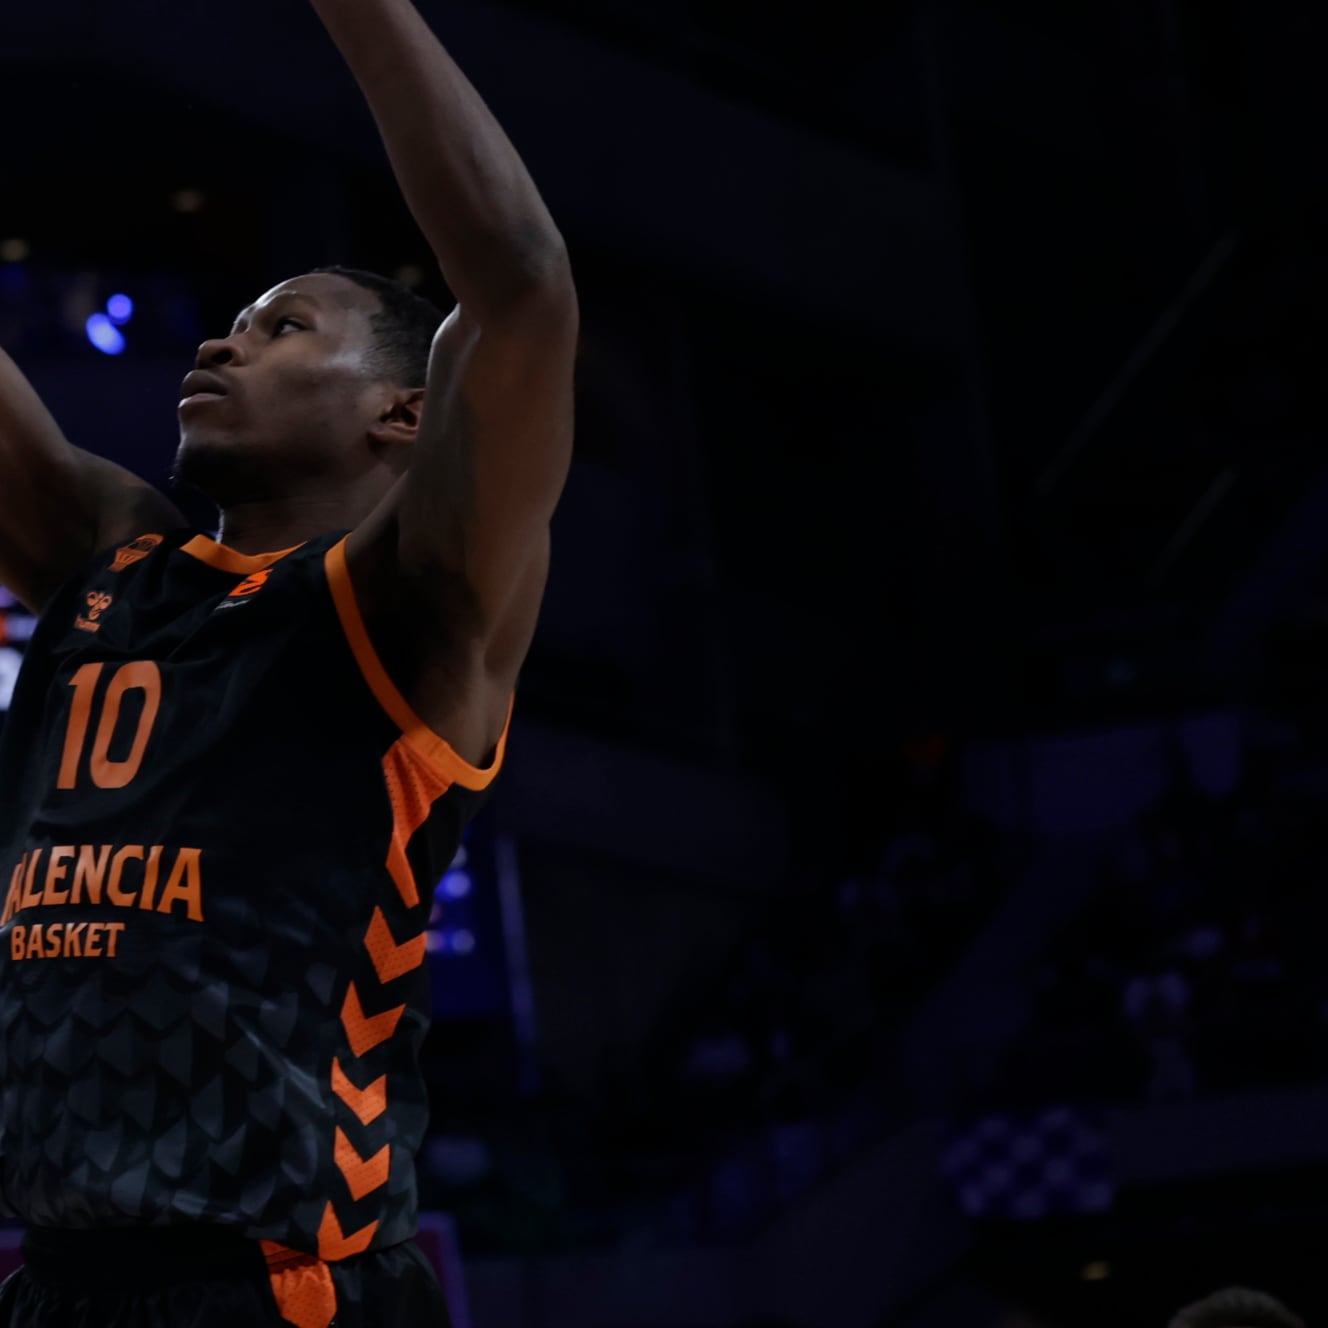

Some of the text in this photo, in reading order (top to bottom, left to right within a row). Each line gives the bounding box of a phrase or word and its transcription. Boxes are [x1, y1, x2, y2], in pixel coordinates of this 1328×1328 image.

[56, 660, 162, 790] 10
[0, 844, 207, 923] ALENCIA
[10, 922, 127, 961] BASKET
